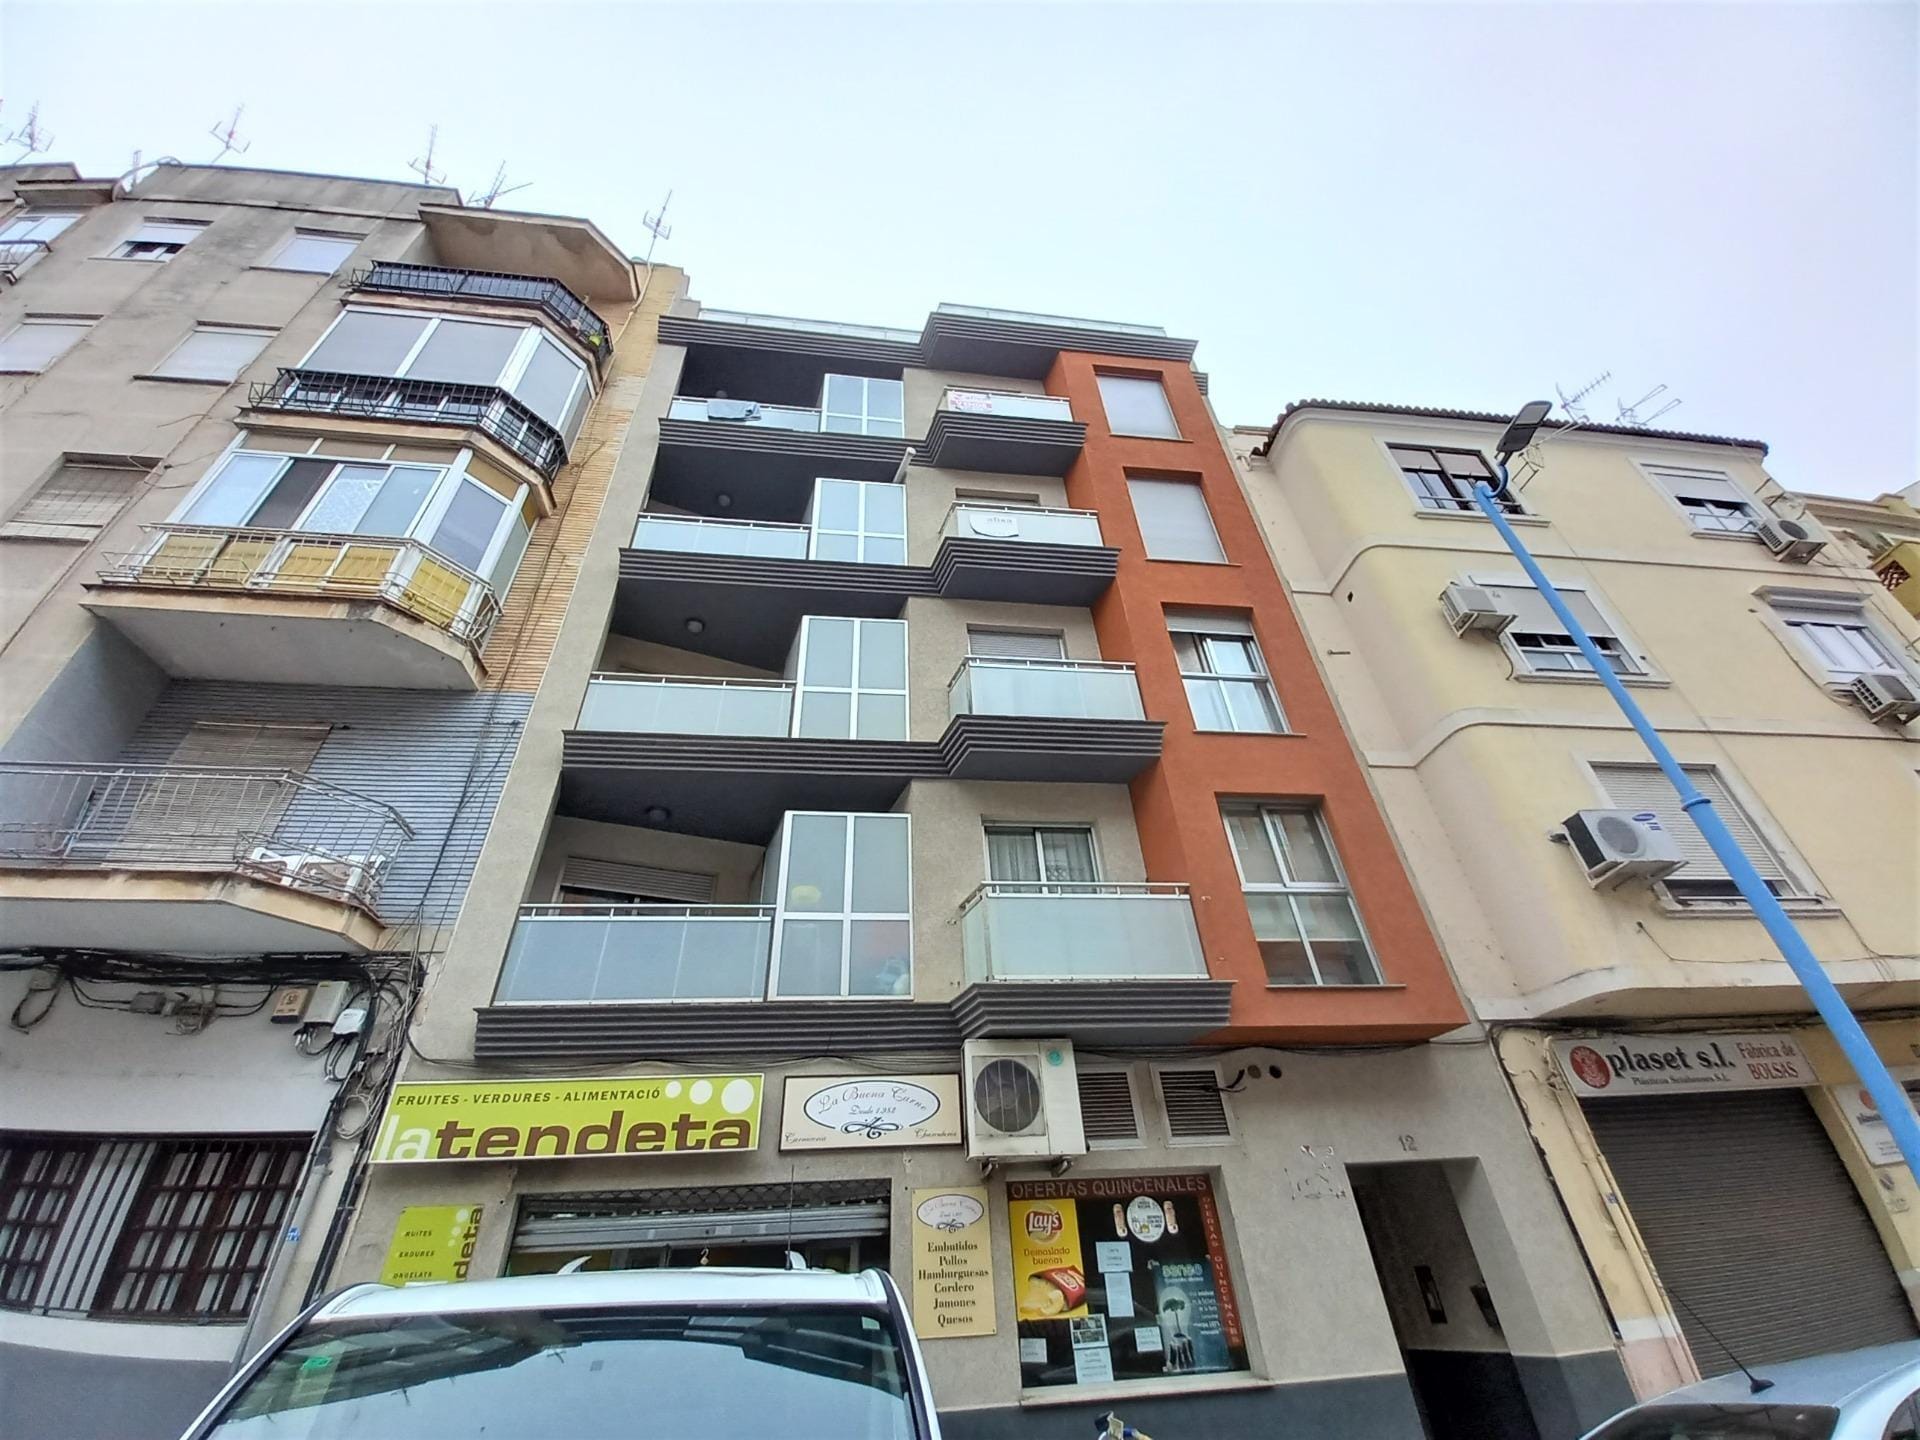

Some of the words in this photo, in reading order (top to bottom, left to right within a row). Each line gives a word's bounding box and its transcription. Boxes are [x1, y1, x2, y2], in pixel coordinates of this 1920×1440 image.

[1781, 1040, 1796, 1057] de
[1605, 1044, 1693, 1078] plaset
[1749, 1061, 1799, 1081] BOLSAS
[396, 1094, 460, 1106] FRUITES
[473, 1092, 552, 1104] VERDURES
[563, 1086, 661, 1102] ALIMENTACIÓ
[842, 1086, 885, 1102] Buena
[1398, 1134, 1418, 1151] 12
[1011, 1180, 1088, 1199] OFERTAS
[1092, 1175, 1208, 1196] QUINCENALES
[927, 1240, 978, 1253] Embutidos
[939, 1254, 968, 1267] Pollos
[918, 1268, 989, 1281] Hamburguesas
[934, 1281, 975, 1294] Cordero
[933, 1297, 976, 1310] Jamones
[937, 1313, 974, 1328] Quesos
